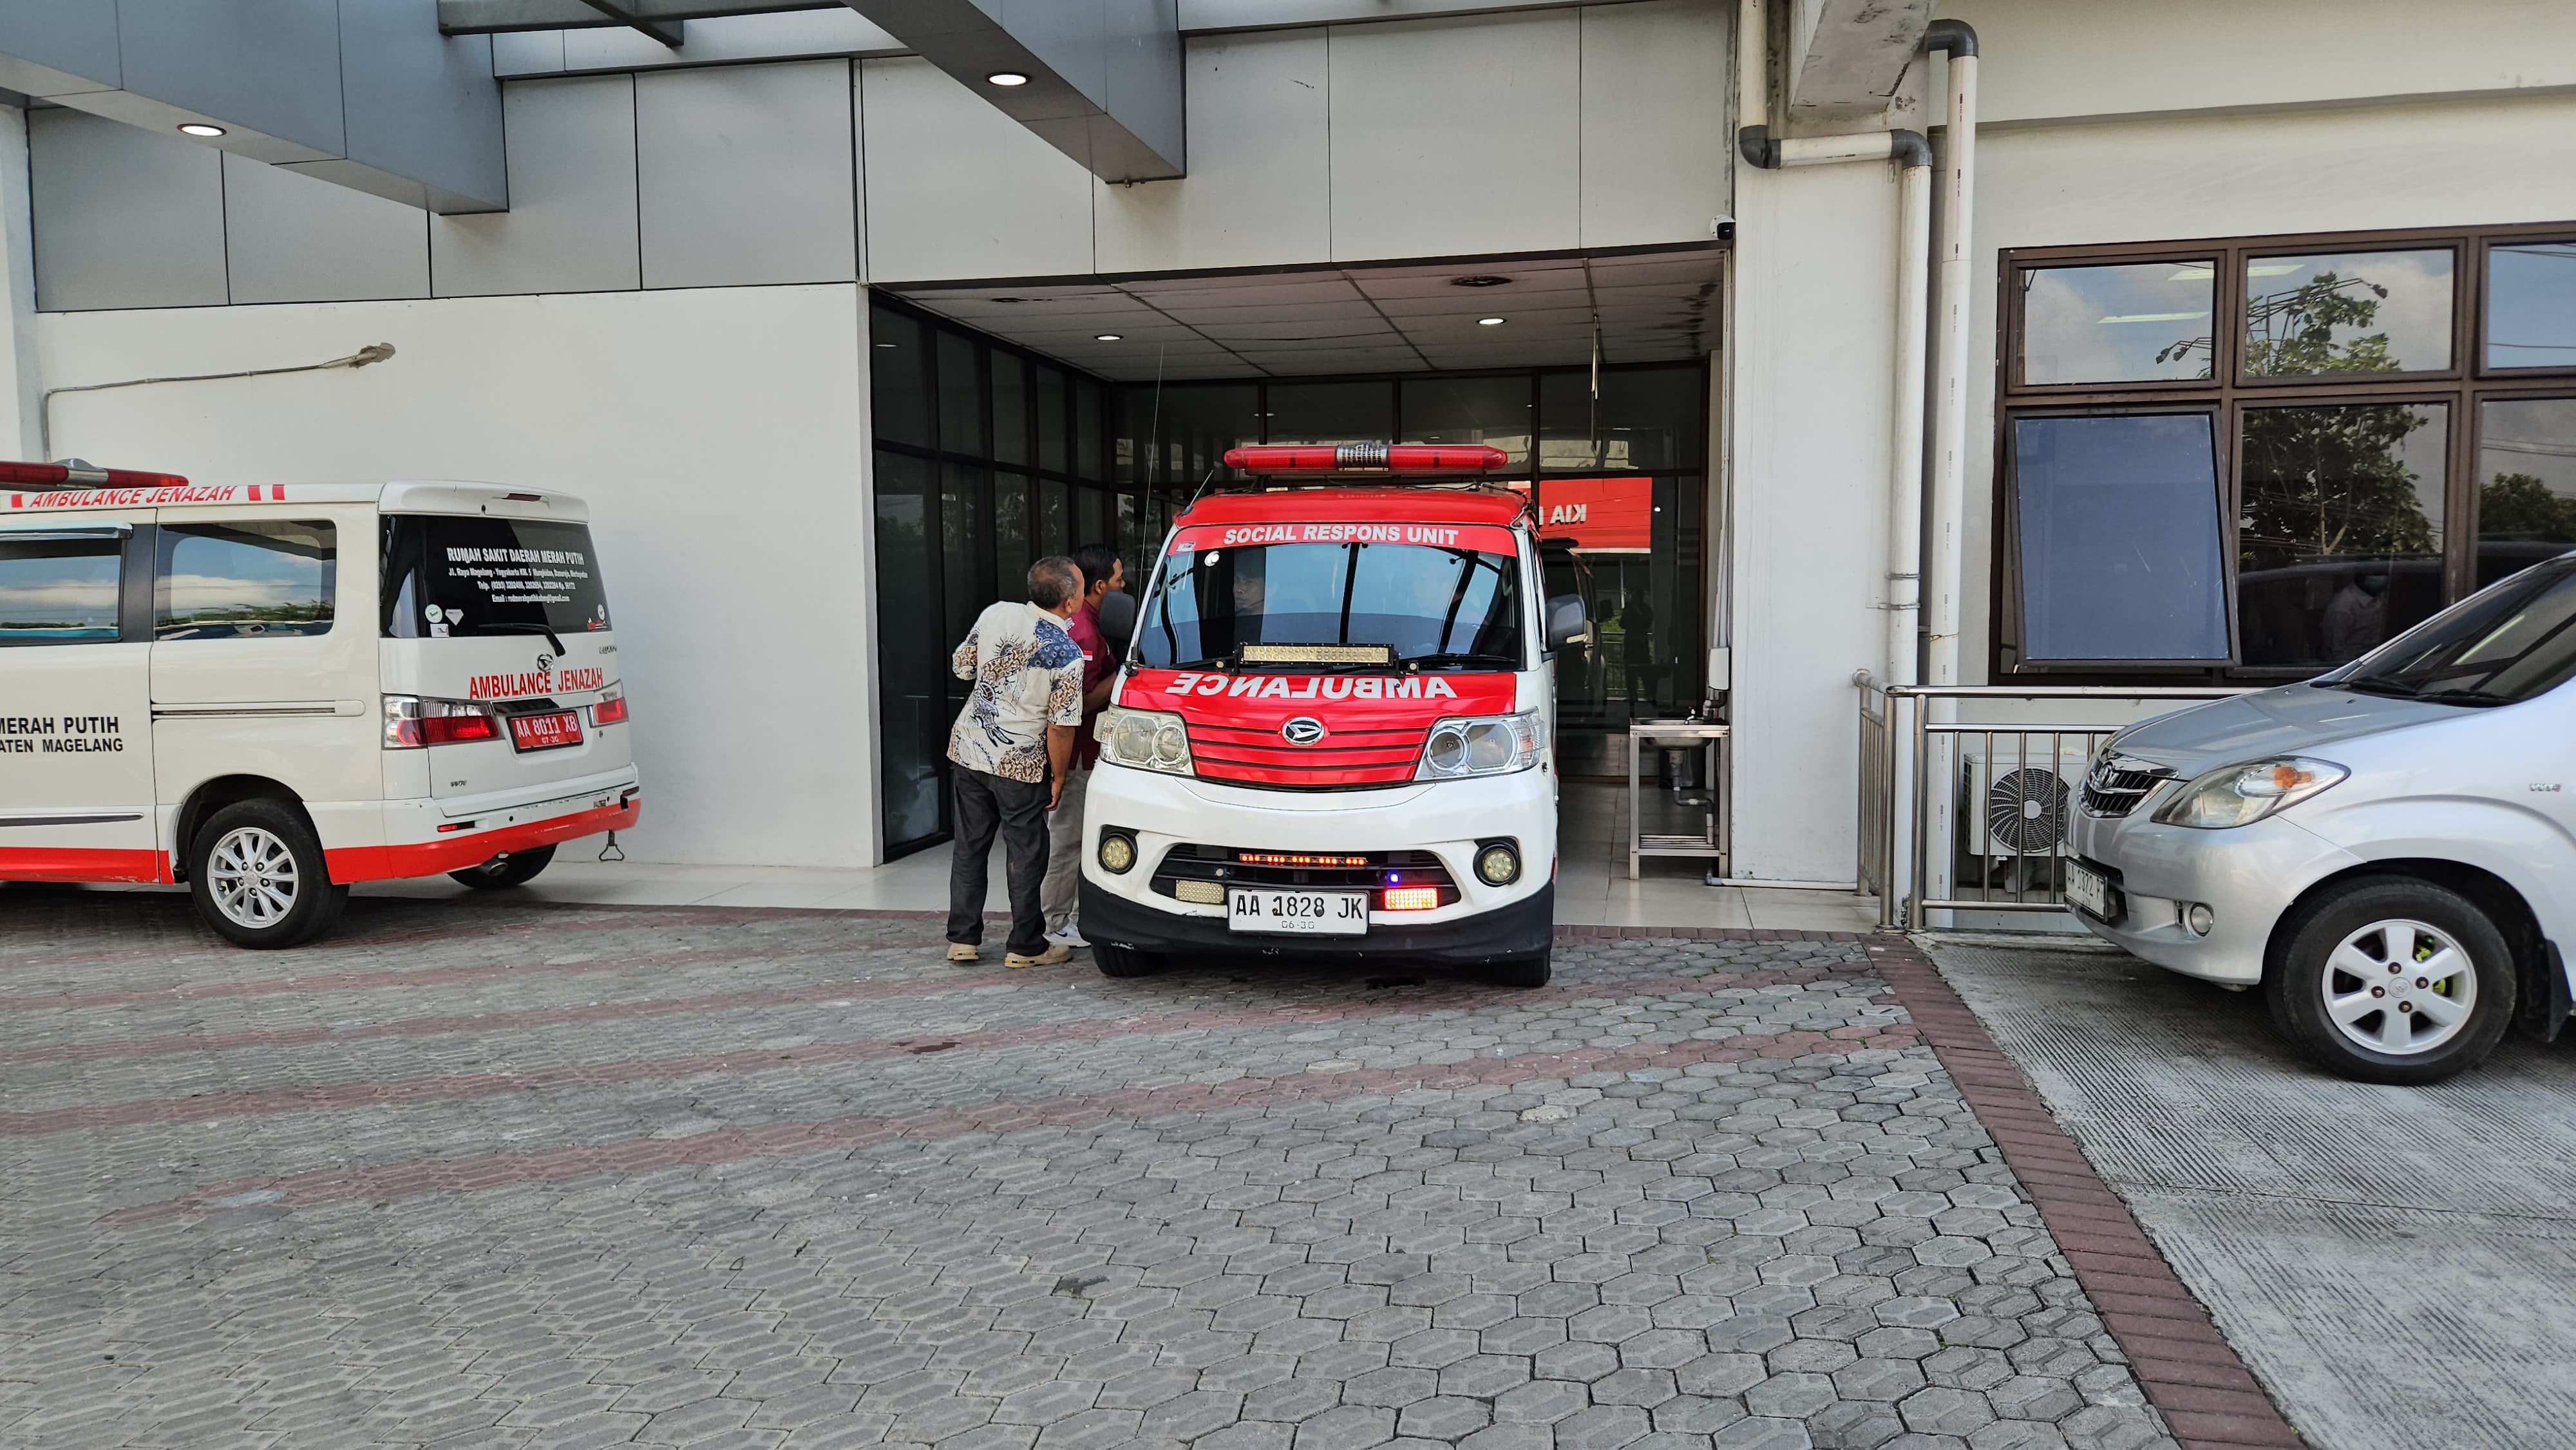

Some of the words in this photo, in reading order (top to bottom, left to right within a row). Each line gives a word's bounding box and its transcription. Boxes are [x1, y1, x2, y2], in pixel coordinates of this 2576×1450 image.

[30, 489, 145, 507] AMBULANCE
[146, 485, 237, 504] JENAZAH
[1223, 525, 1297, 545] SOCIAL
[1303, 525, 1400, 541] RESPONS
[1407, 527, 1459, 545] UNIT
[446, 547, 482, 563] RUMAH
[483, 548, 508, 561] SAKIT
[509, 549, 541, 563] DAERAH
[540, 550, 565, 564] MERAH
[565, 552, 585, 565] PUTIH
[469, 672, 552, 700] AMBULANCE
[558, 668, 603, 692] JENAZAH
[63, 717, 118, 733] PUTIH
[516, 720, 531, 738] AA
[533, 717, 560, 735] 8011
[564, 715, 578, 733] XB
[43, 738, 123, 753] MAGELANG
[1236, 894, 1260, 916] AA
[1272, 896, 1325, 918] 1828
[1338, 898, 1363, 919] JK
